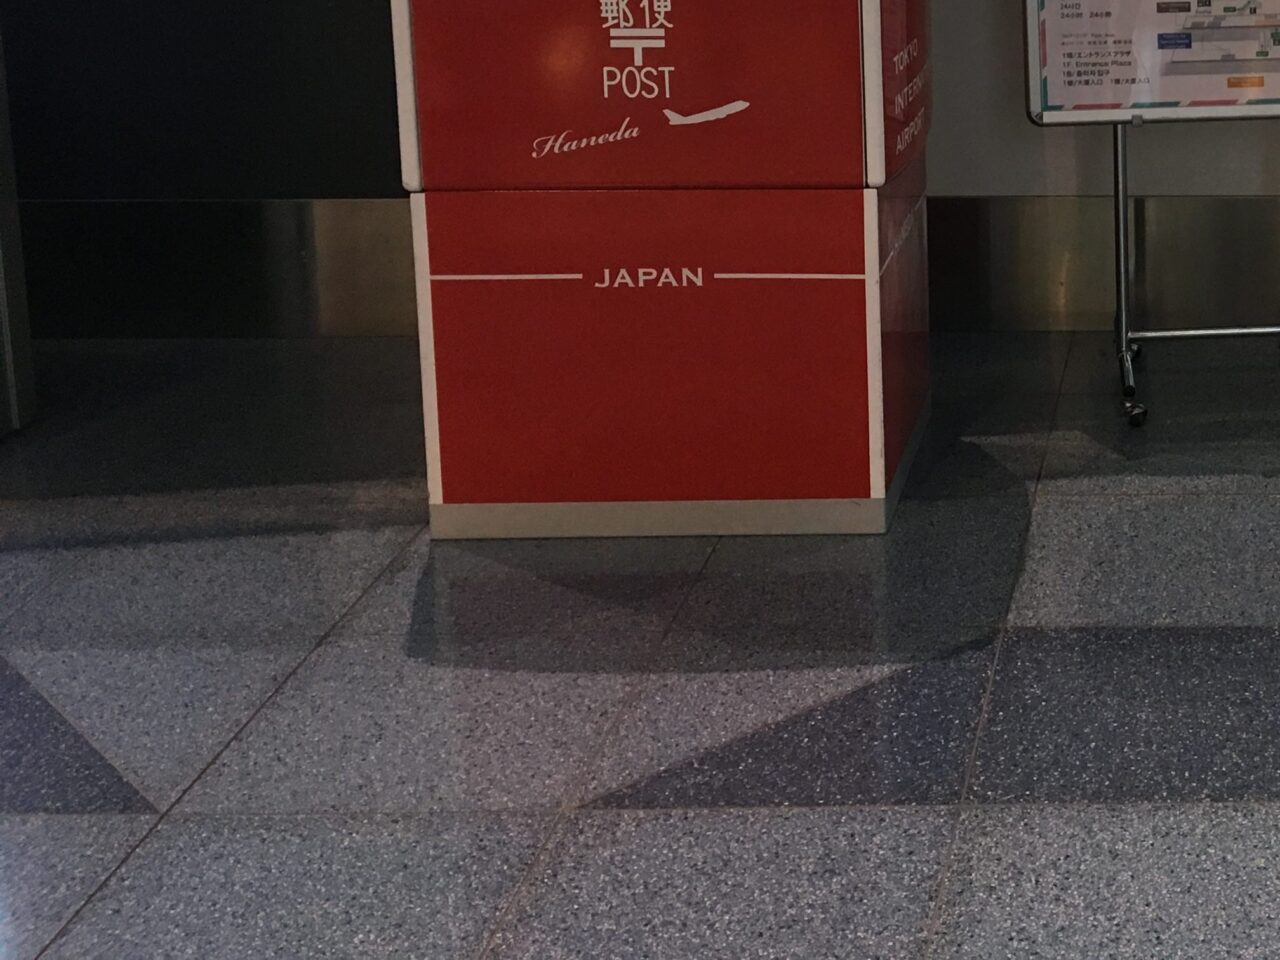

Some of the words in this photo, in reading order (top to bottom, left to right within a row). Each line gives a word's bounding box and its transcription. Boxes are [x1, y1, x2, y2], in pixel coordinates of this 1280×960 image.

[893, 38, 919, 75] TOKYO
[602, 66, 675, 99] POST
[531, 117, 641, 159] Haneda
[594, 267, 703, 288] JAPAN
